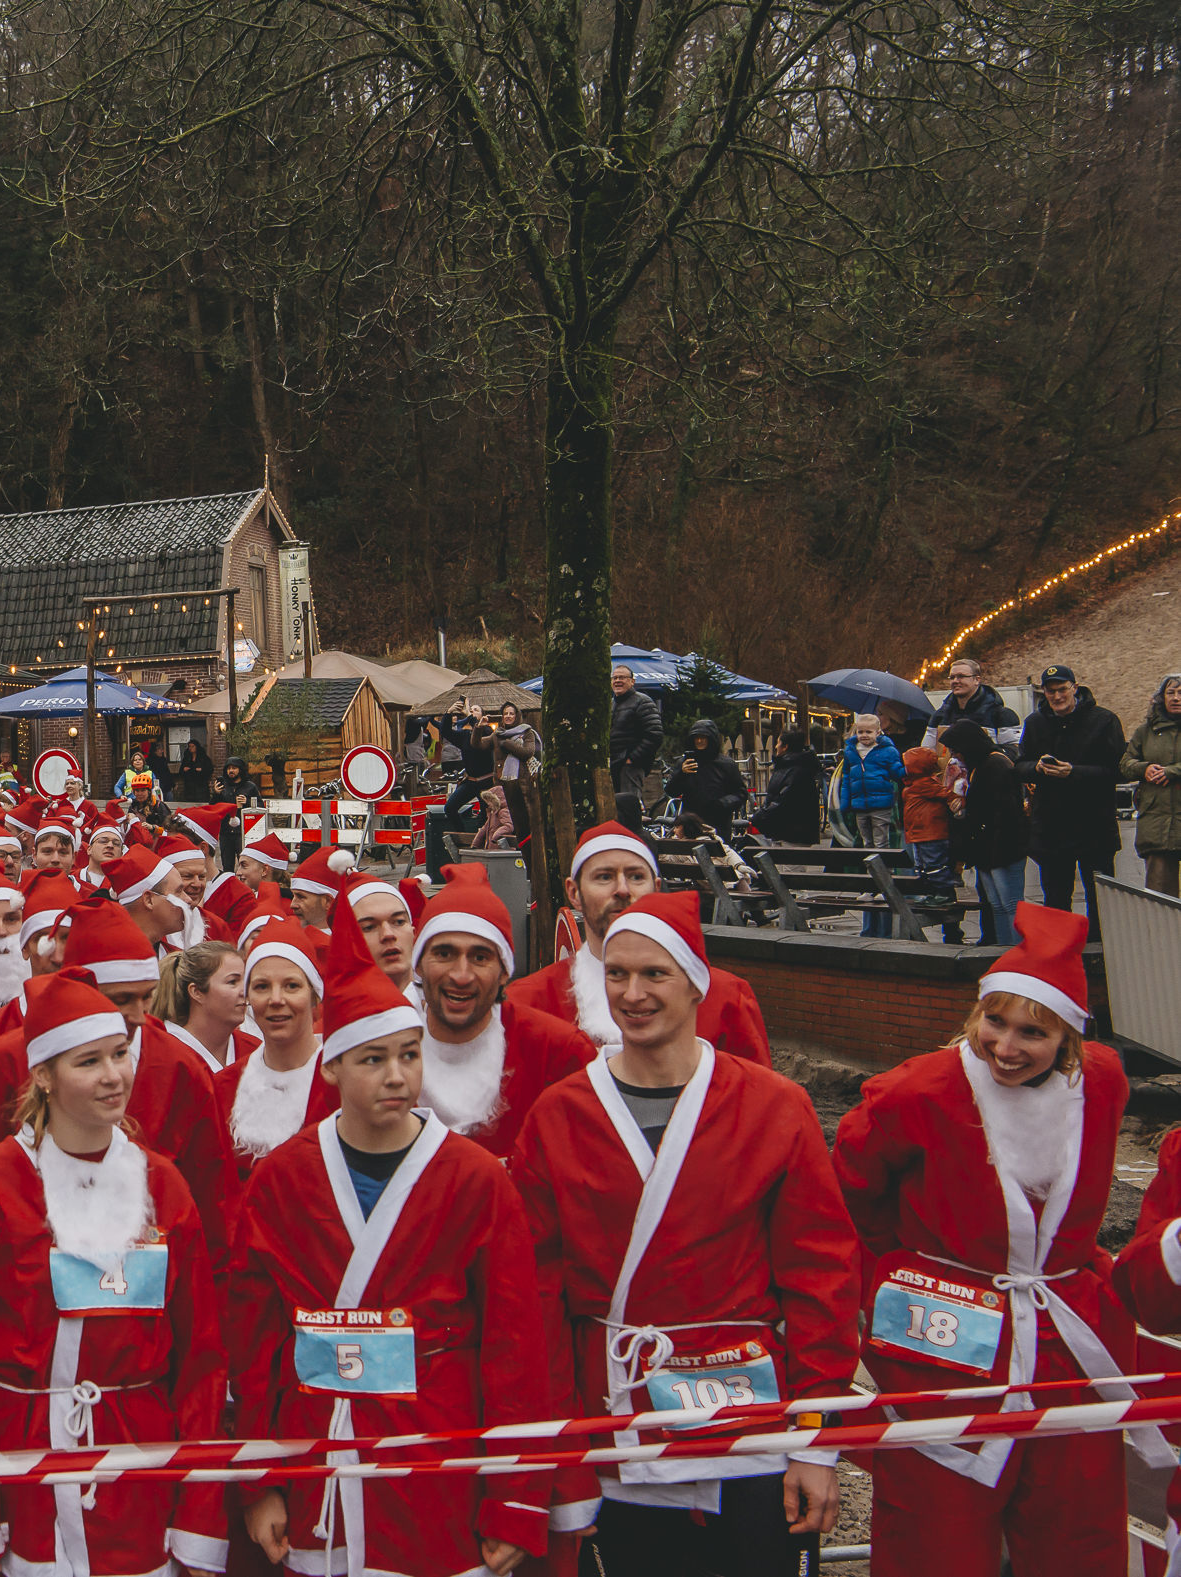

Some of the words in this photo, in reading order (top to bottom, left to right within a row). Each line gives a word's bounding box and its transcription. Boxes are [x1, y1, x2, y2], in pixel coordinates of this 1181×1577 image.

[291, 577, 306, 611] HONKY
[19, 697, 88, 708] PERON
[99, 1258, 128, 1295] 4
[889, 1269, 937, 1288] ERST
[937, 1280, 976, 1300] RUN
[346, 1311, 383, 1325] RUN
[906, 1304, 959, 1347] 18
[336, 1344, 365, 1380] 5
[705, 1348, 742, 1365] RUN
[671, 1374, 755, 1409] 103
